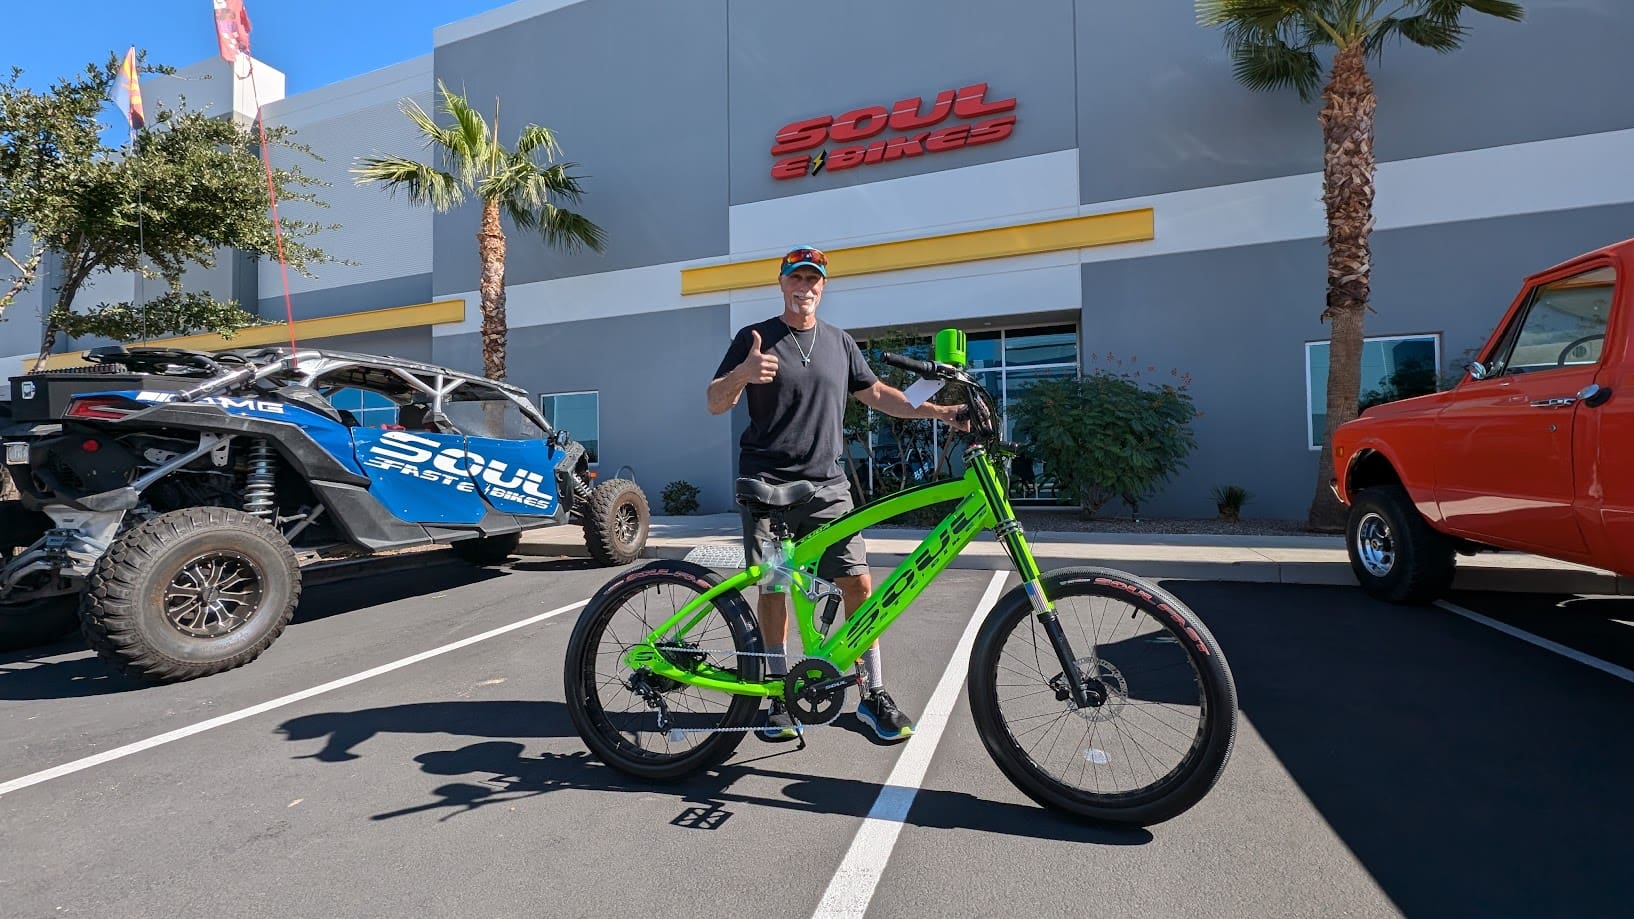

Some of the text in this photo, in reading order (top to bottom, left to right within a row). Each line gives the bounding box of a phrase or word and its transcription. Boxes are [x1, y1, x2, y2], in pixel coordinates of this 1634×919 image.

[770, 82, 1017, 156] SOUL
[363, 456, 459, 486] FAST
[490, 487, 551, 510] BIKES
[370, 431, 553, 501] SOUL
[846, 503, 987, 649] SOUL
